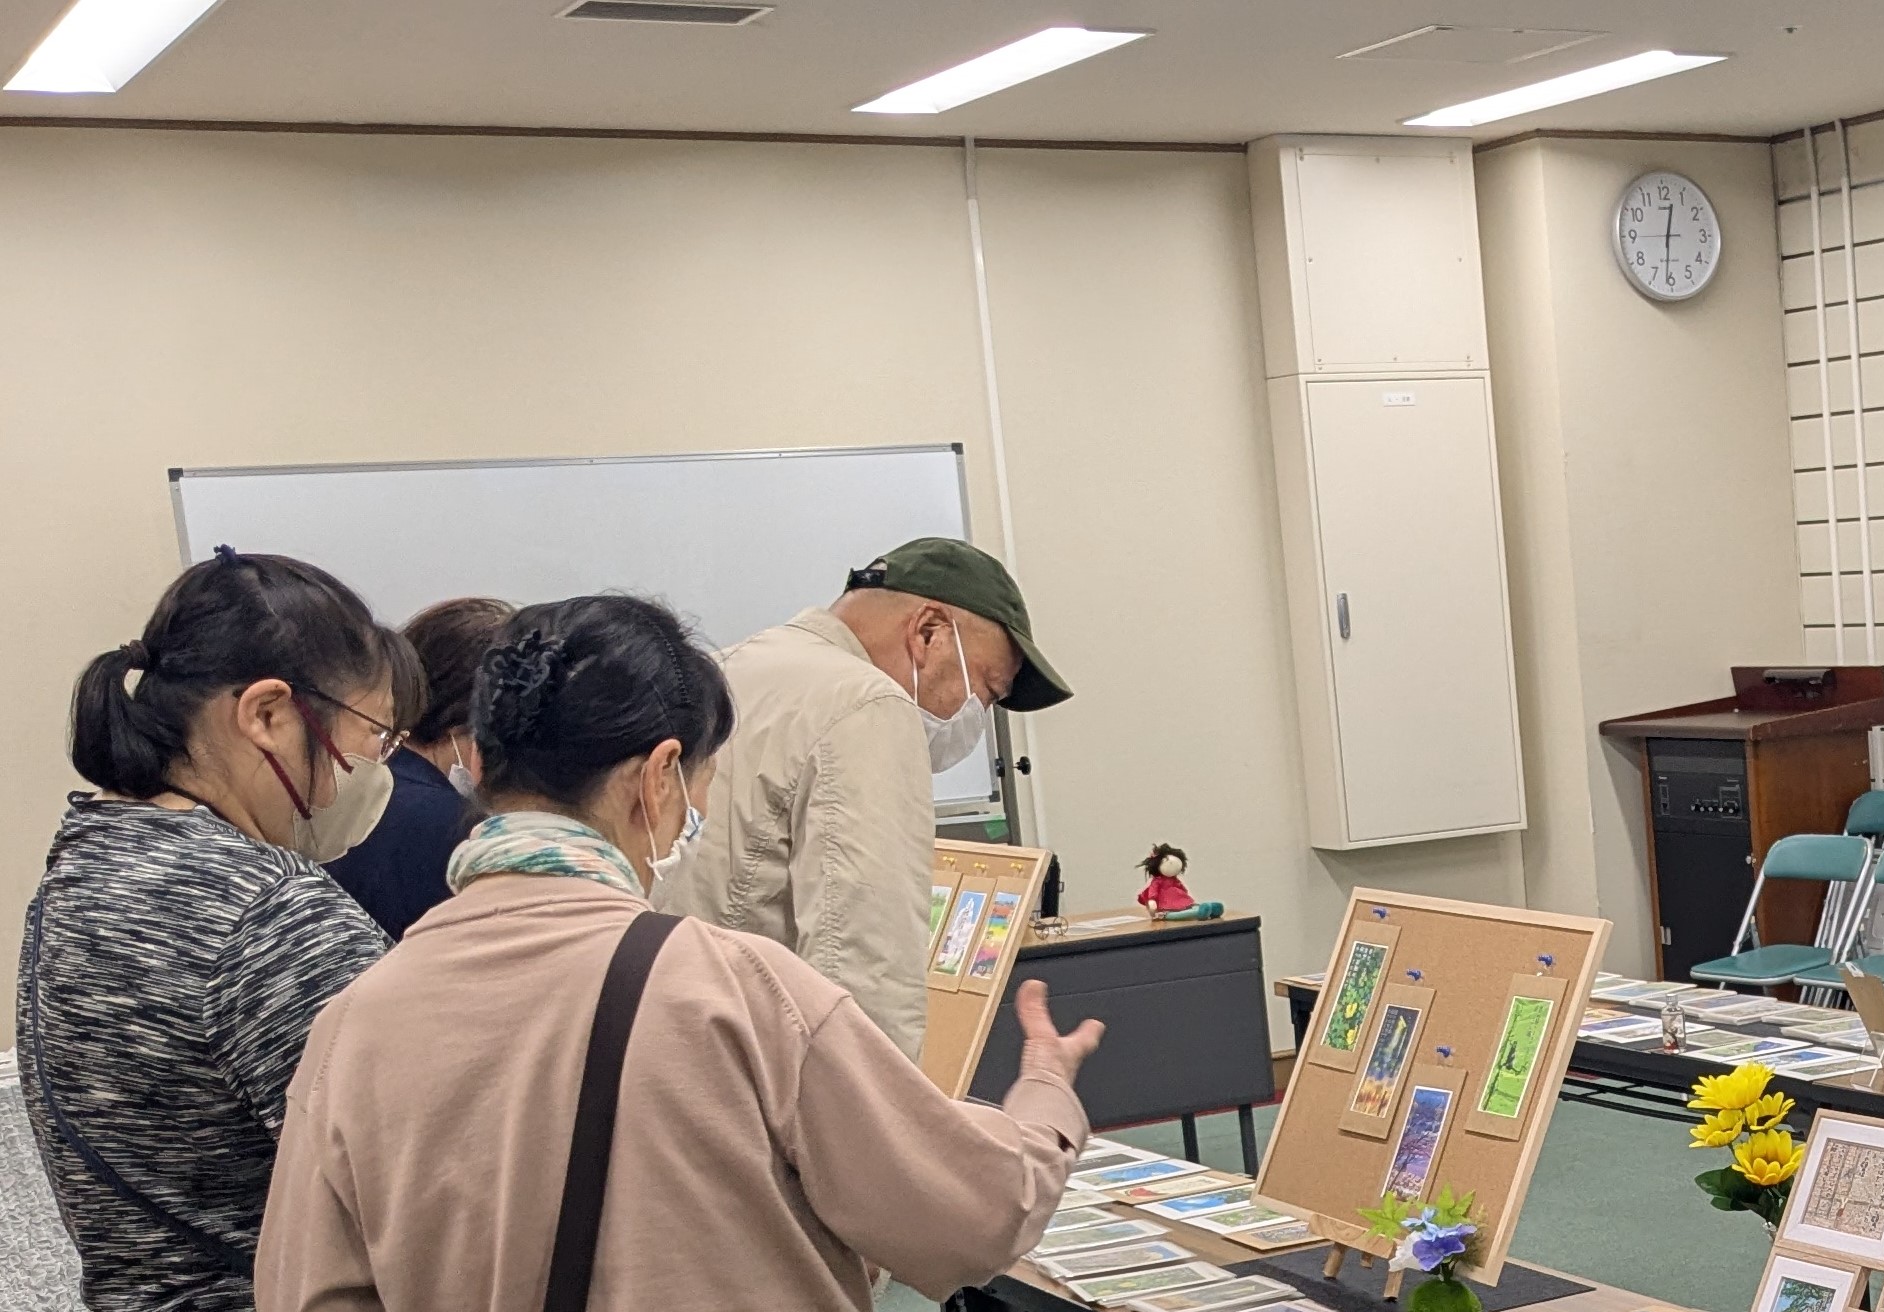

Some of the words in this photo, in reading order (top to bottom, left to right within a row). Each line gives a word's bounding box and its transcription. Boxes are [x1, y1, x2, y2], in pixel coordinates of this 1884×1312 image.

[1641, 192, 1652, 207] 11
[1657, 186, 1670, 200] 12
[1631, 207, 1644, 222] 10
[1691, 206, 1700, 221] 2
[1628, 229, 1637, 244] 9
[1699, 229, 1707, 243] 3
[1636, 251, 1645, 266] 8
[1695, 251, 1703, 264] 4
[1651, 266, 1659, 281] 7
[1667, 271, 1676, 287] 6
[1684, 265, 1692, 280] 5
